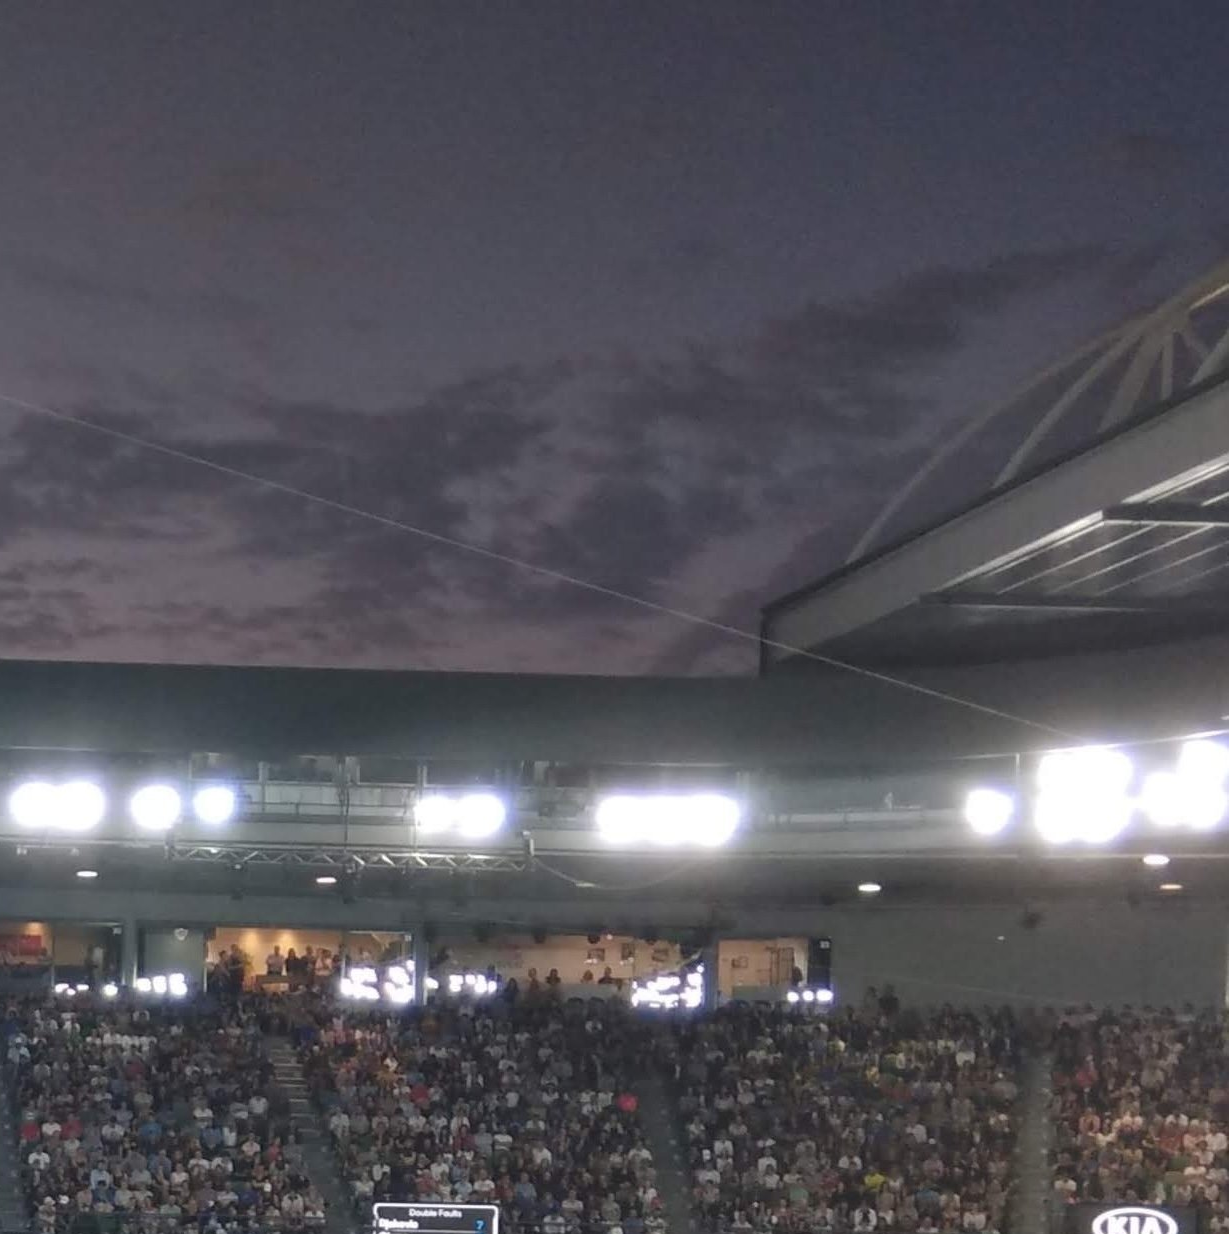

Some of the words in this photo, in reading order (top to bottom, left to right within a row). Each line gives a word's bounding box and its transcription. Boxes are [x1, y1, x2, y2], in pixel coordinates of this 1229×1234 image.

[408, 1208, 438, 1218] Double
[438, 1208, 463, 1218] Faults
[475, 1220, 485, 1230] 7
